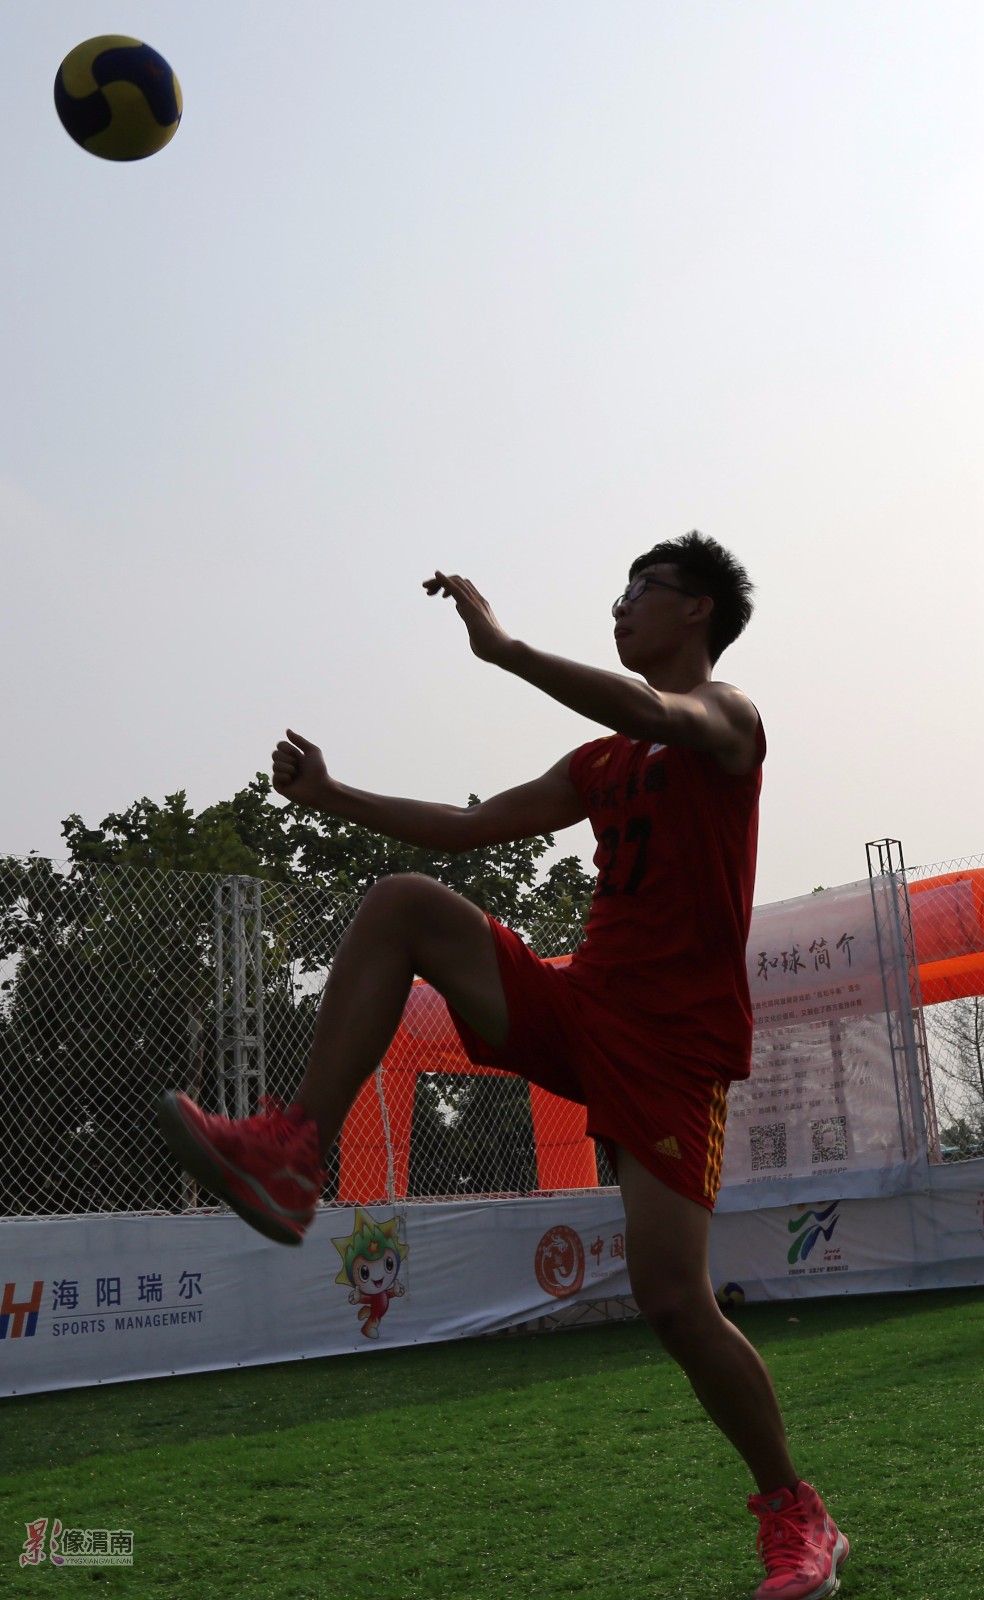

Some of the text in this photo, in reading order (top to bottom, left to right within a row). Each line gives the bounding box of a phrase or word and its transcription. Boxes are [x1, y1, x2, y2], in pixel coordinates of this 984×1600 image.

[757, 932, 855, 981] 和球简介
[52, 1270, 203, 1311] 海阳瑞尔
[53, 1310, 203, 1337] SPORTS MANAGEMENT
